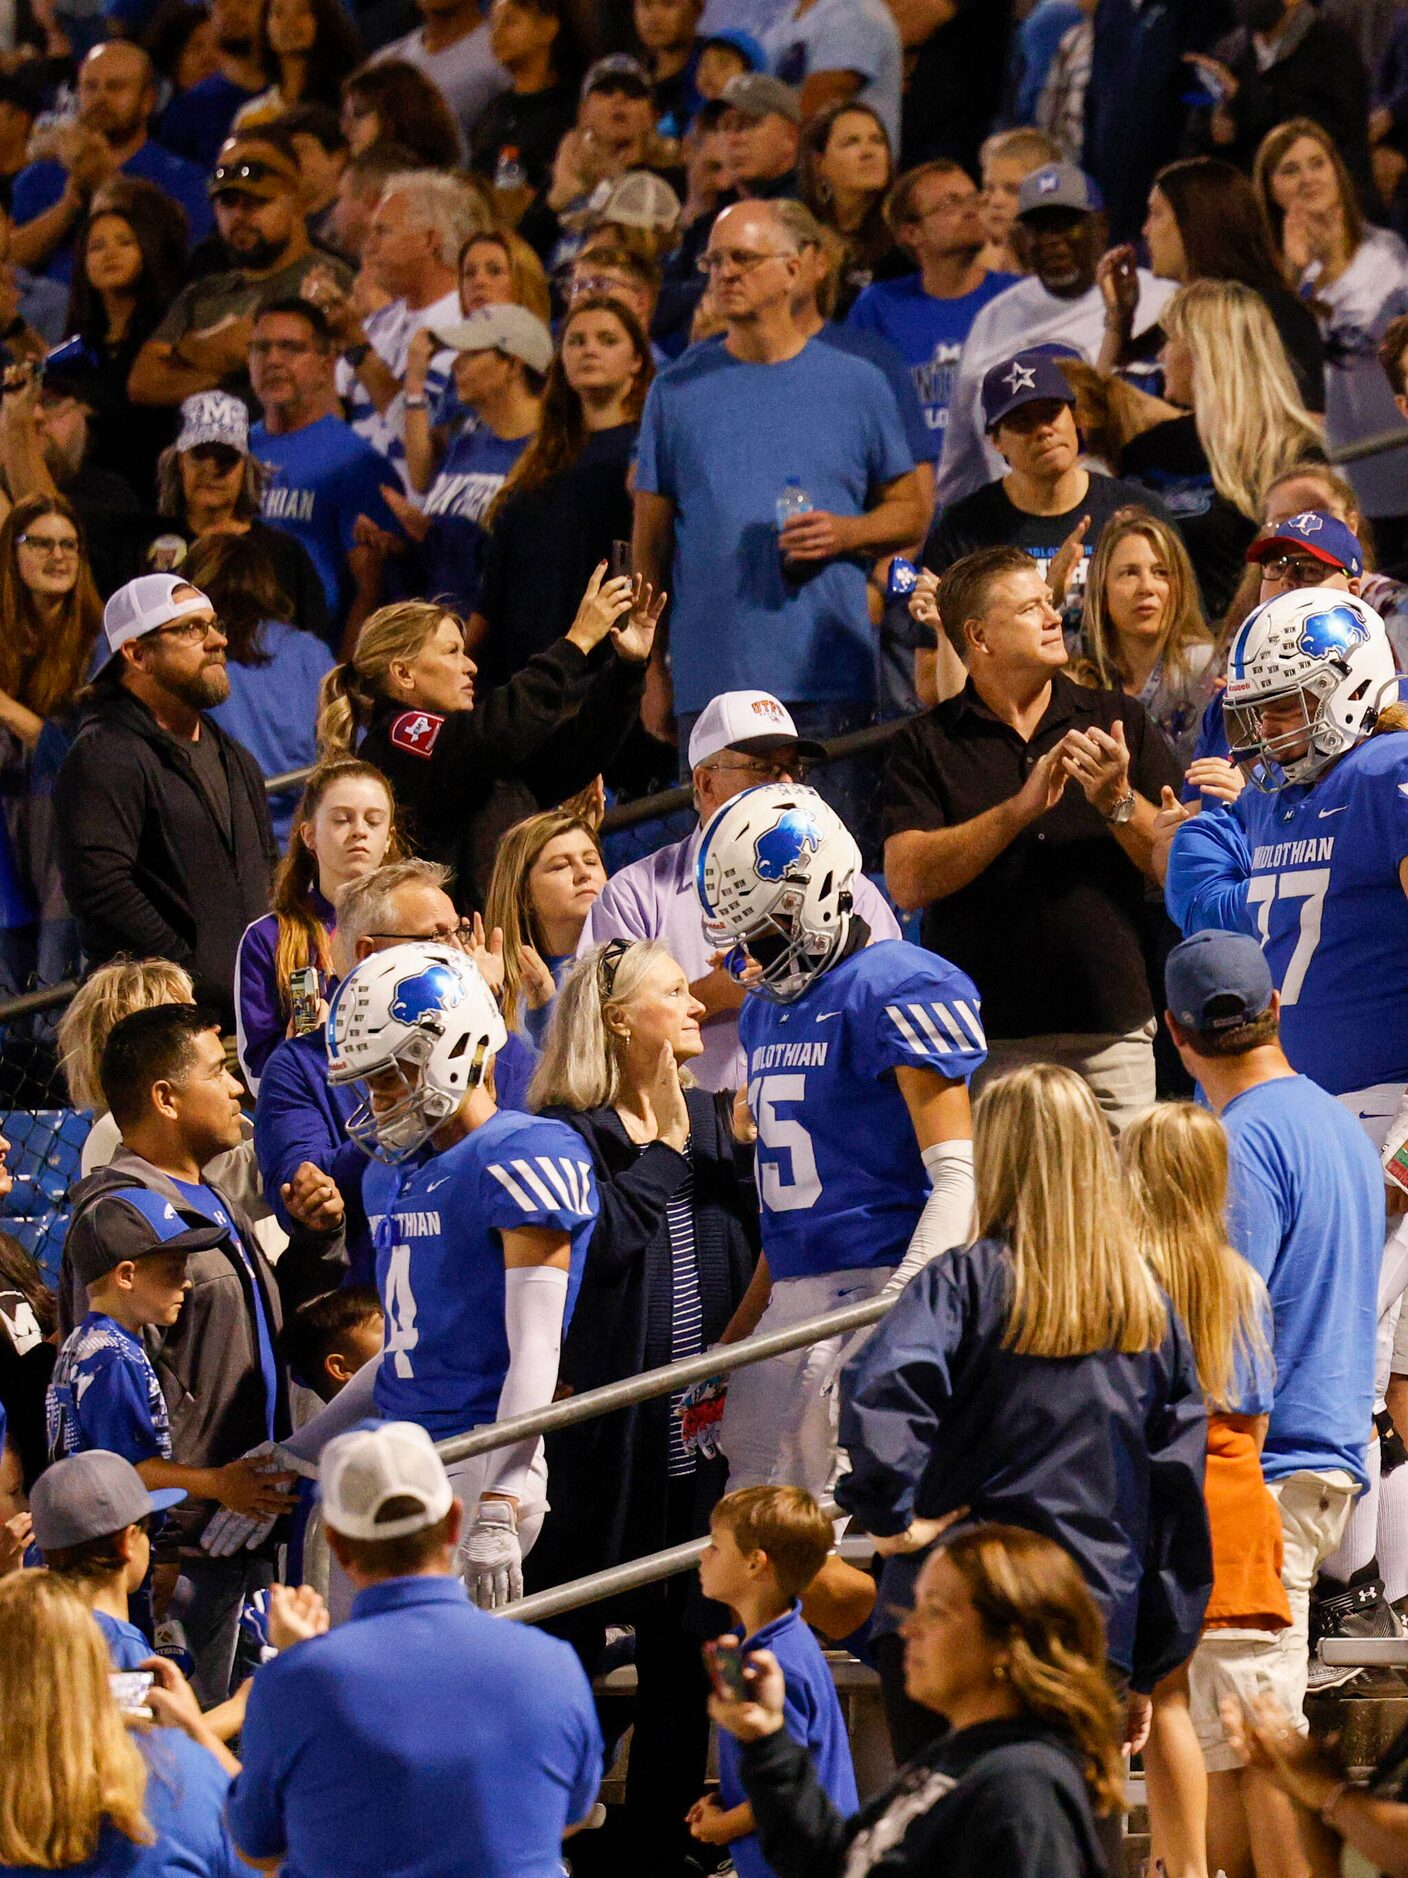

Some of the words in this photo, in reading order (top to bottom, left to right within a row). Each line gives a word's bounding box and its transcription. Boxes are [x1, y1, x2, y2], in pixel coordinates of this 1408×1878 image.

[1247, 867, 1331, 1007] 77
[752, 1042, 829, 1076] LOTHIAN
[367, 1211, 441, 1240] THIAN
[384, 1244, 419, 1379] 4
